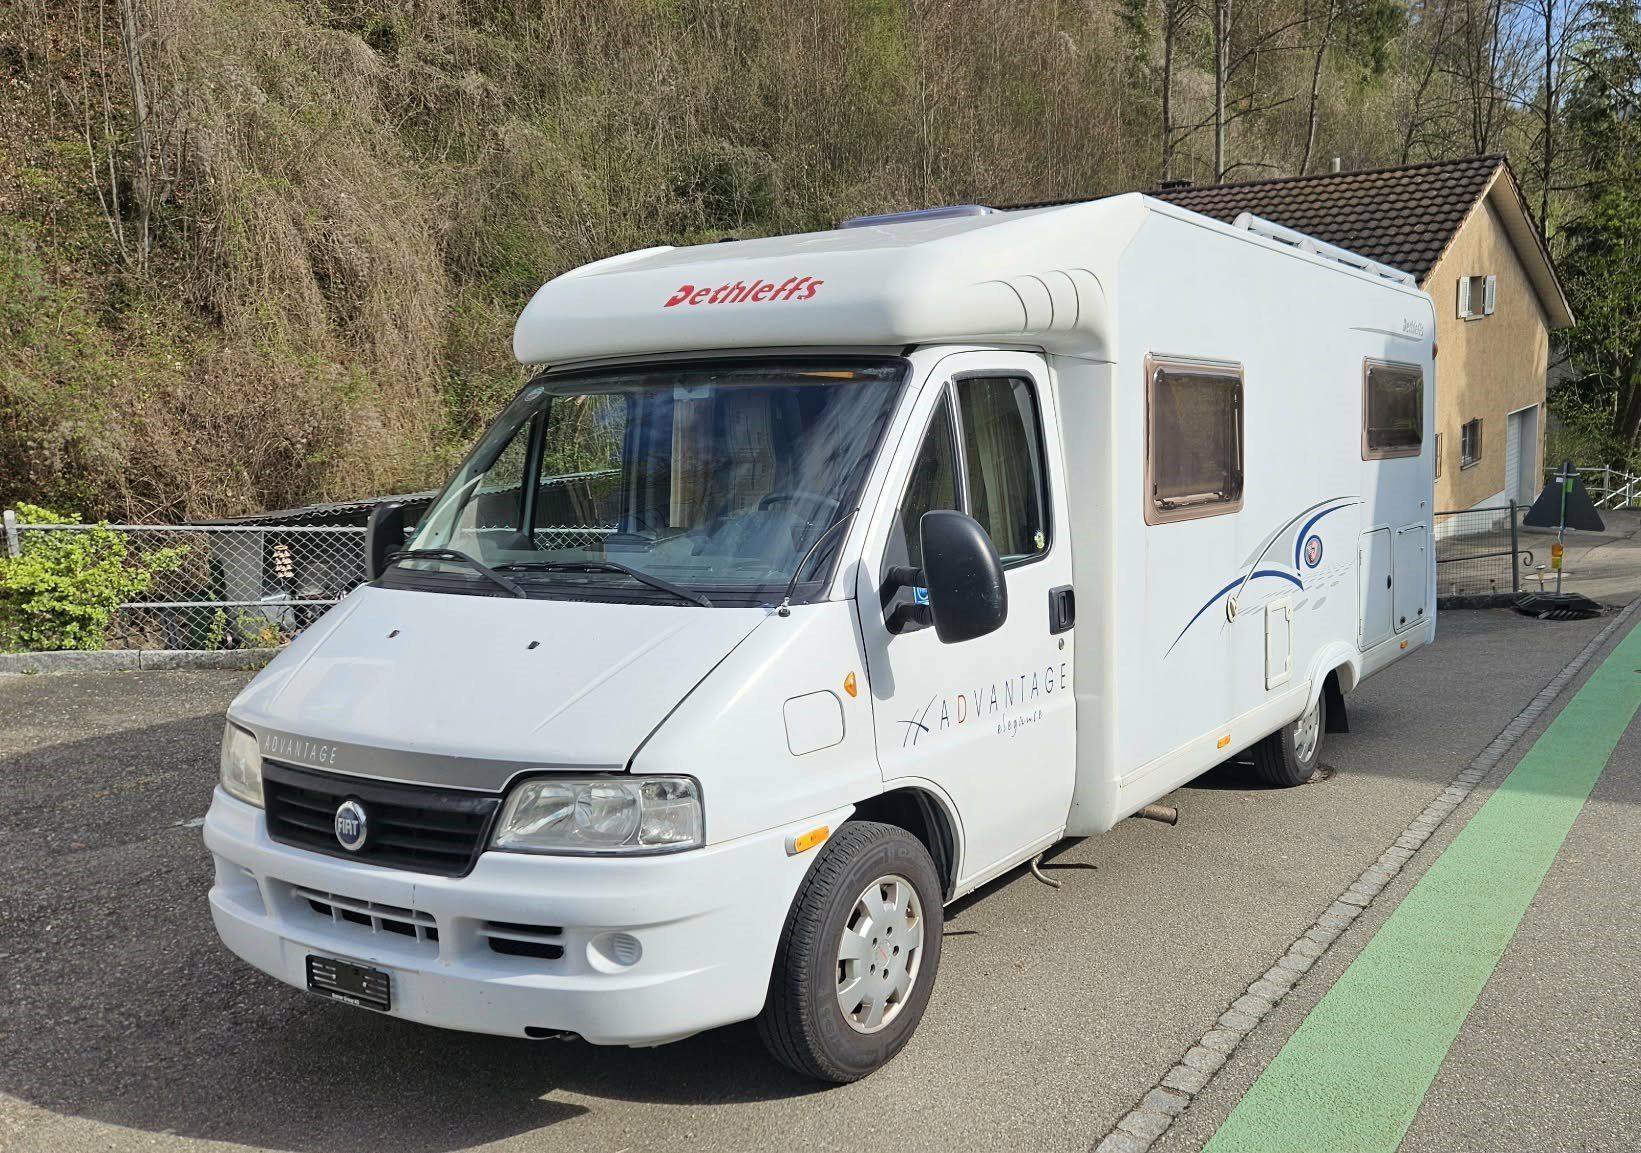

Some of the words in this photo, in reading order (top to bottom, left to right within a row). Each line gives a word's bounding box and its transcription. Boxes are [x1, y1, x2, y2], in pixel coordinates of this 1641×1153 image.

[663, 276, 825, 307] Dethleffs
[940, 663, 1066, 730] ADVANTAGE
[997, 710, 1042, 738] elegance
[264, 735, 337, 764] ADVANTAGE
[338, 817, 359, 836] FIAT
